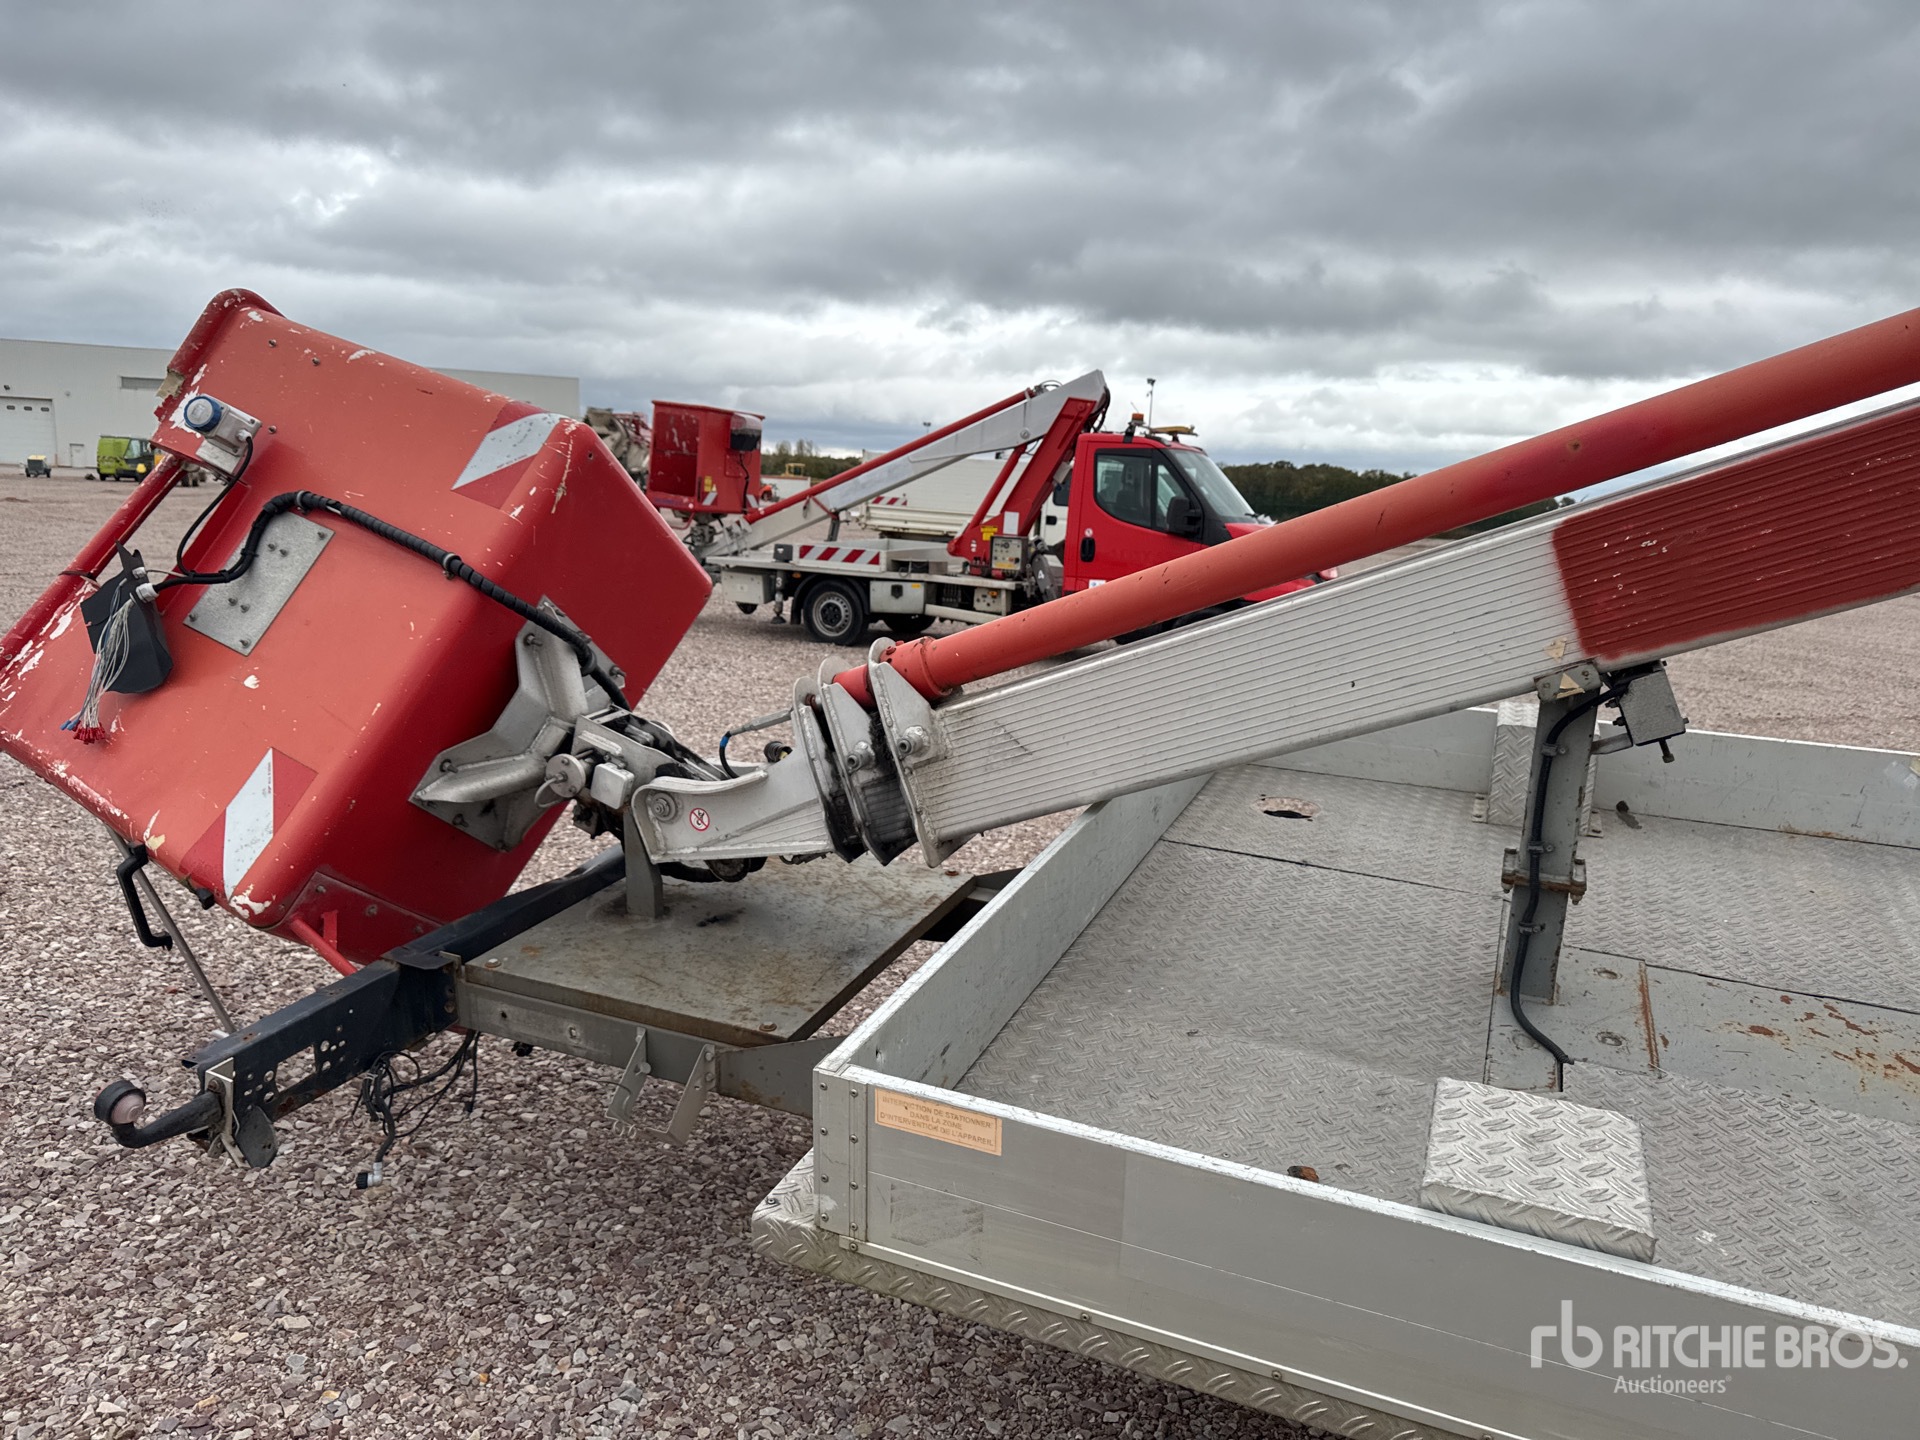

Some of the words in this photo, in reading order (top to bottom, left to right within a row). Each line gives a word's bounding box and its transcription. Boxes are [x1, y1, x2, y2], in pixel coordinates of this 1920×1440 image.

[775, 577, 783, 588] 3
[882, 1096, 932, 1114] INTERDICTION
[933, 1108, 943, 1117] DE
[945, 1111, 991, 1128] STATIONNER
[909, 1112, 930, 1122] DANS
[931, 1116, 940, 1125] LA
[942, 1119, 962, 1130] ZONE
[880, 1111, 939, 1132] D'INTERVENTION
[940, 1127, 950, 1136] DE
[951, 1129, 994, 1146] L'APPAREIL
